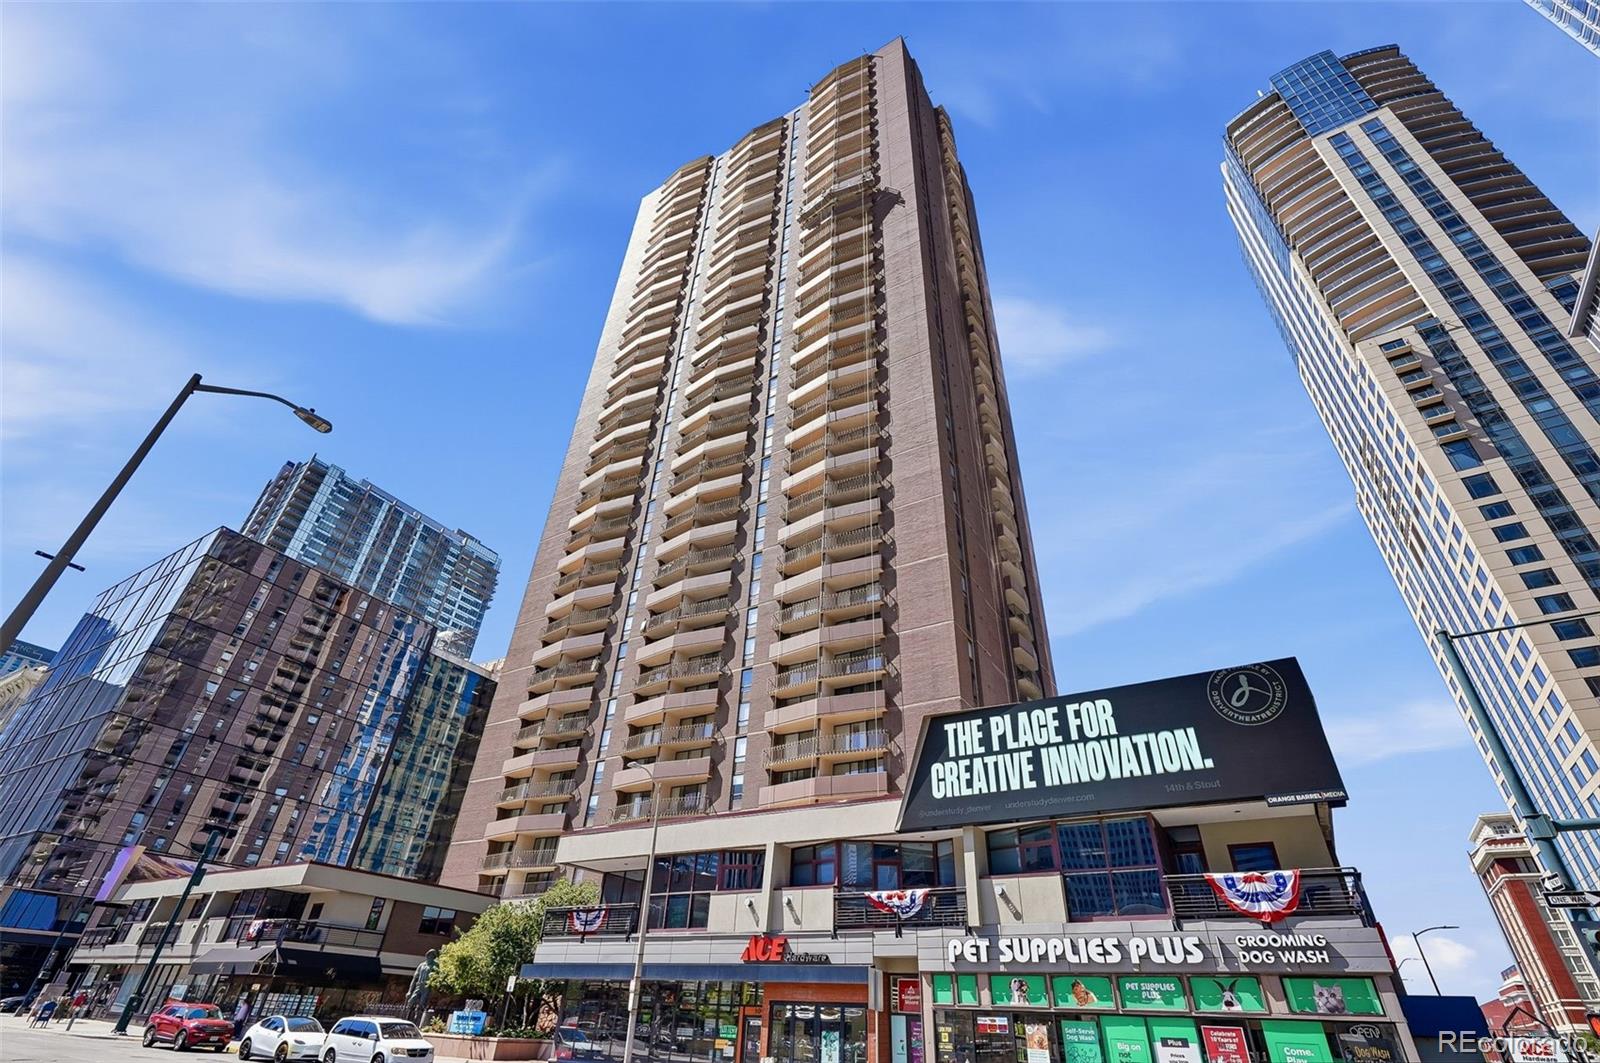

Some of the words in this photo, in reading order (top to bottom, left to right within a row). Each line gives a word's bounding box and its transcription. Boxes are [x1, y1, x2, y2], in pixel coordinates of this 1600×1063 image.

[943, 718, 986, 758] THE
[989, 706, 1063, 752] PLACE
[1065, 698, 1119, 741] FOR
[930, 750, 1038, 800] CREATIVE
[1040, 727, 1215, 787] INNOVATION.
[1164, 781, 1185, 793] 14th
[1186, 782, 1194, 791] &
[1194, 779, 1222, 790] Stout
[1004, 792, 1096, 810] understudydenver.com
[1267, 794, 1296, 804] ORANGE
[1296, 792, 1321, 801] BARREL
[1551, 896, 1567, 904] ONE
[1570, 896, 1587, 904] WAY
[741, 934, 785, 961] ACE
[785, 952, 827, 962] Hardware
[1235, 934, 1327, 948] GROOMING
[948, 937, 990, 963] PET
[998, 937, 1122, 964] SUPPLIES
[1128, 937, 1204, 965] PLUS
[1239, 950, 1275, 964] DOG
[1278, 950, 1330, 964] WASH
[1125, 982, 1139, 991] PET
[1140, 982, 1176, 991] SUPPLIES
[1141, 991, 1161, 999] PLUS
[1066, 1034, 1078, 1042] Dog
[1349, 1025, 1380, 1039] OPEN
[1117, 1042, 1130, 1052] Big
[1283, 1047, 1314, 1056] Come.
[1354, 1046, 1371, 1058] DOG
[1370, 1046, 1391, 1060] WASH
[1520, 1040, 1553, 1056] ACE
